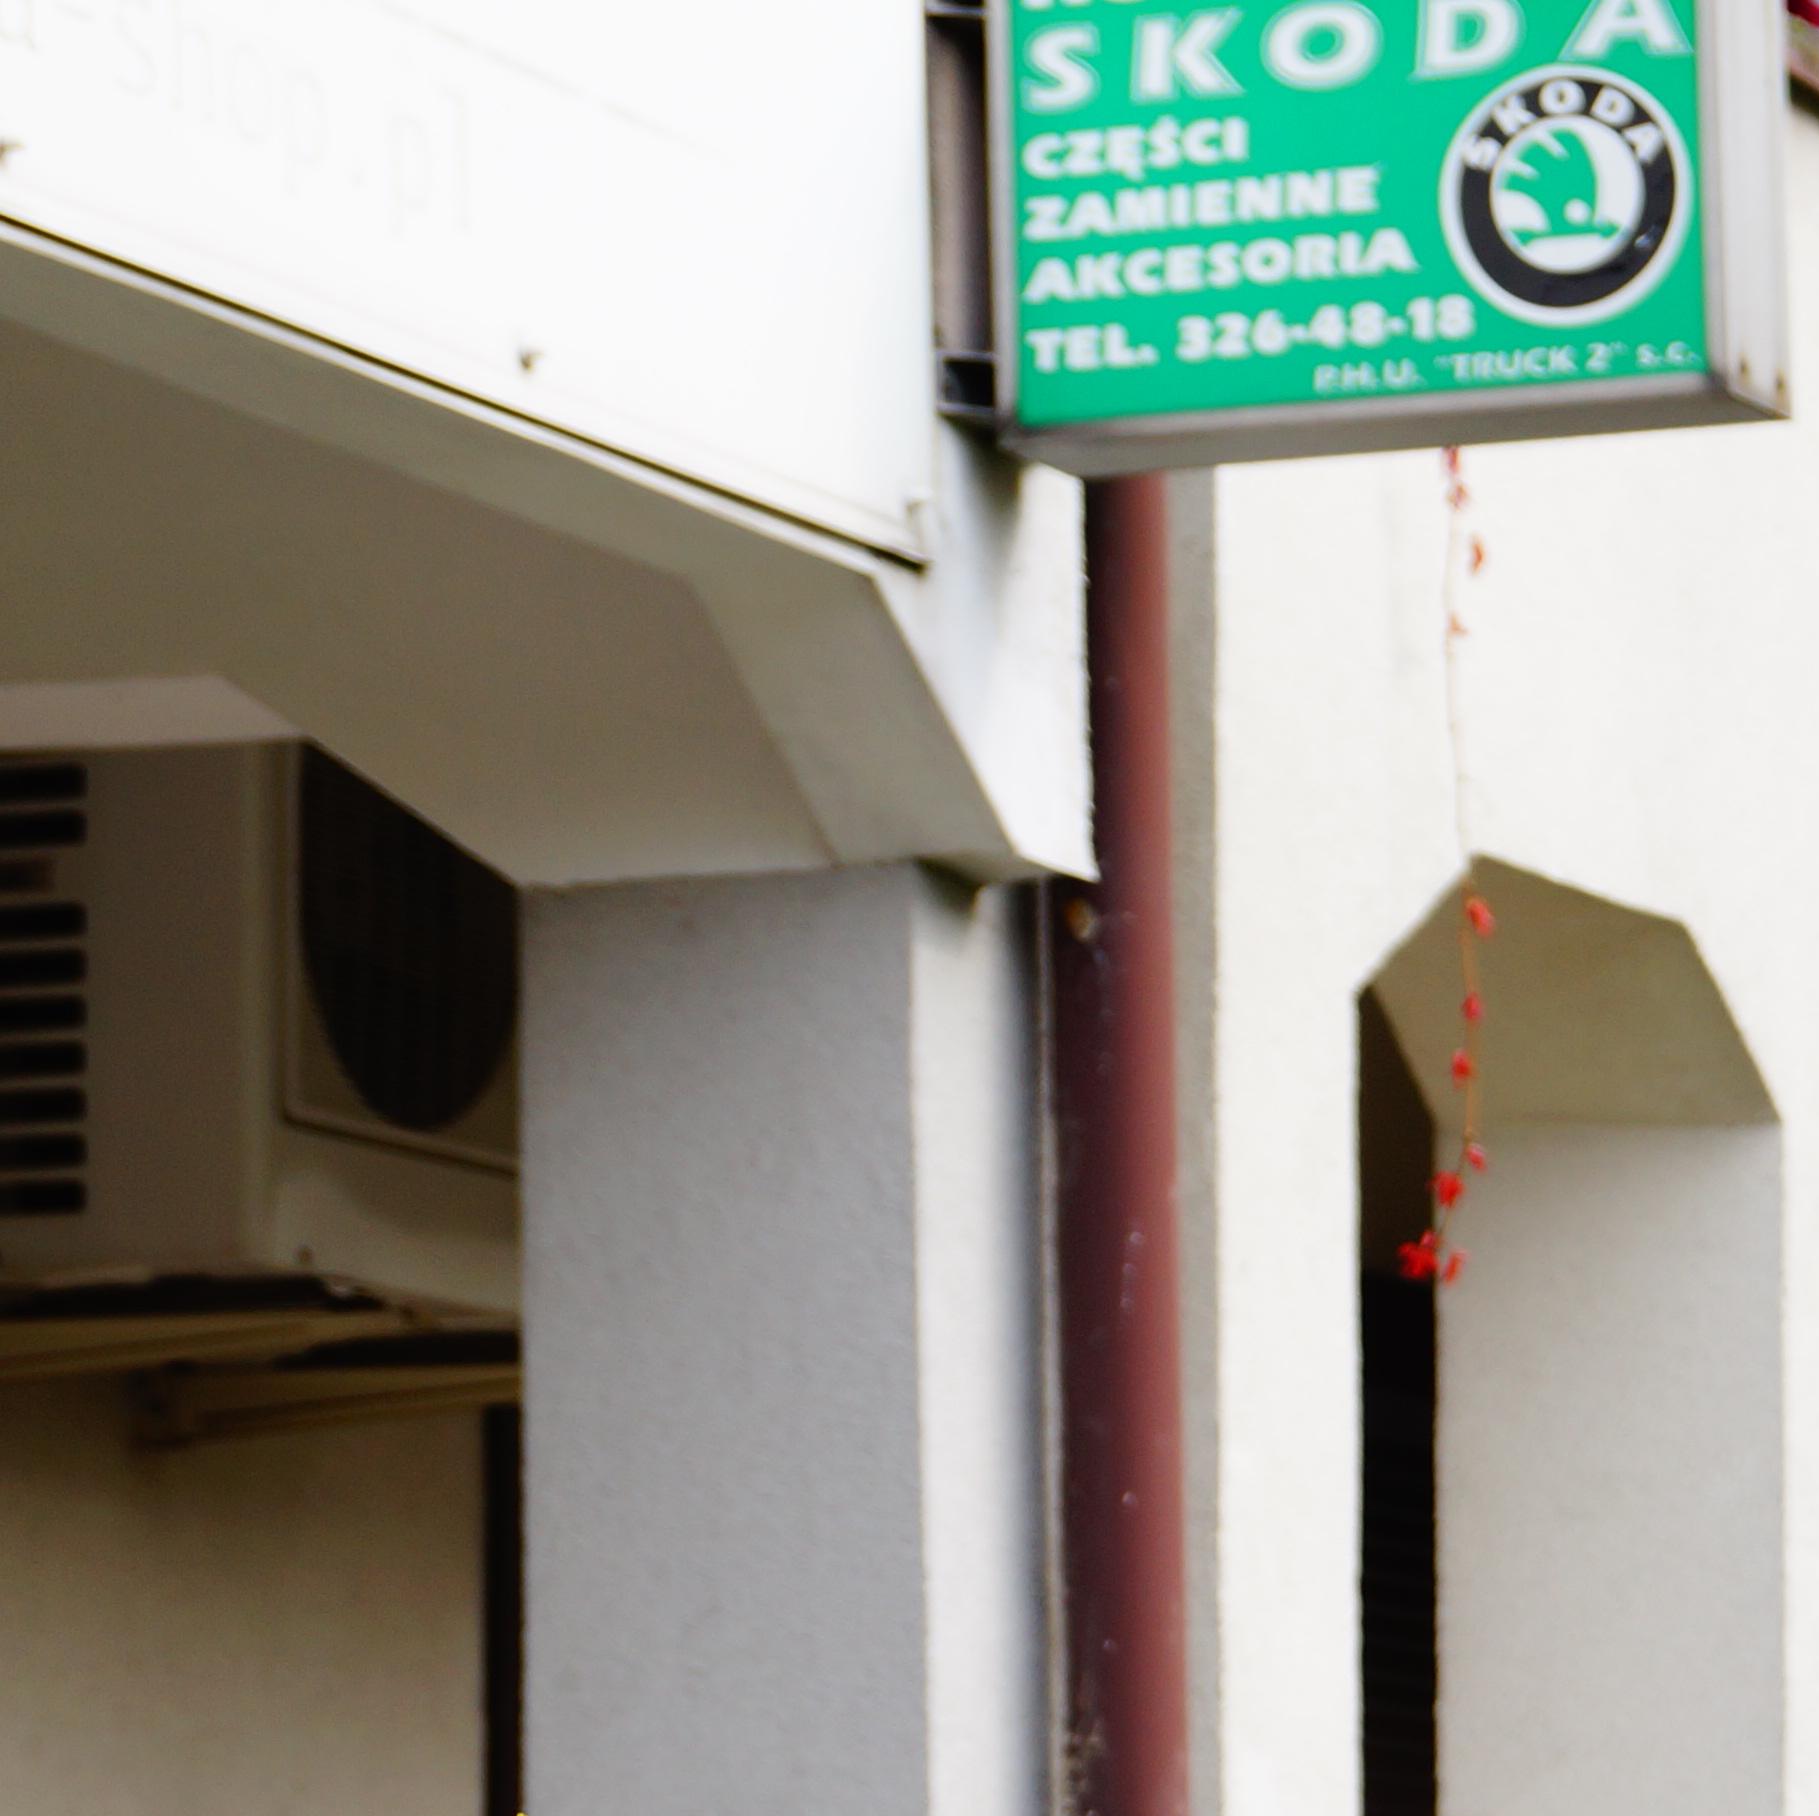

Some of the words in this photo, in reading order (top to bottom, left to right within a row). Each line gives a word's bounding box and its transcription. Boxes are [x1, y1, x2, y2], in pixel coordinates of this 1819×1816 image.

[1021, 0, 1694, 115] SKODA
[1022, 114, 1249, 182] CZĘŚCI
[1023, 164, 1382, 243] ZAMIENNE
[1021, 226, 1421, 303] AKCESORIA
[1024, 322, 1160, 373] TEL.
[1174, 294, 1477, 363] 326-48-18
